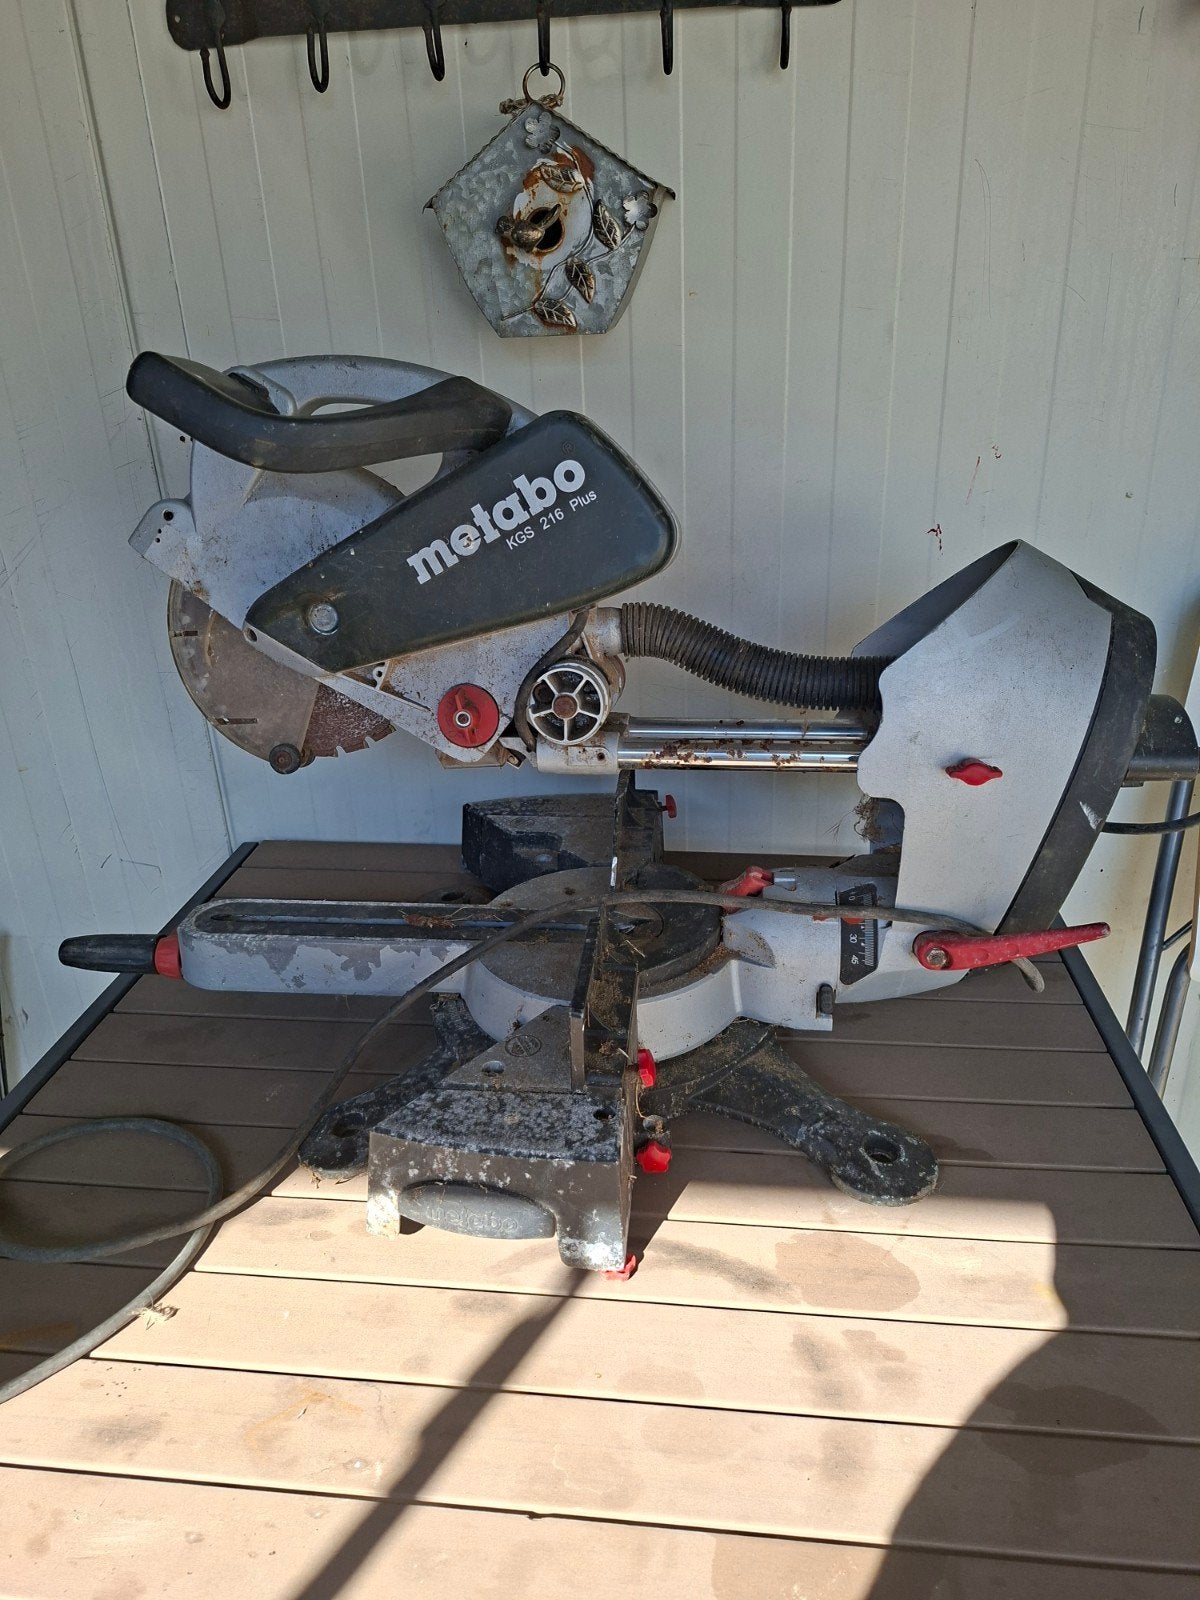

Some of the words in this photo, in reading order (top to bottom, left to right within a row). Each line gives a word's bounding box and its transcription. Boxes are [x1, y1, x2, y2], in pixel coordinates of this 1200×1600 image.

[406, 459, 585, 585] metabo
[506, 526, 535, 550] KGS
[539, 508, 565, 531] 216
[569, 490, 597, 512] Plus
[849, 933, 858, 943] 30
[850, 954, 859, 965] 45
